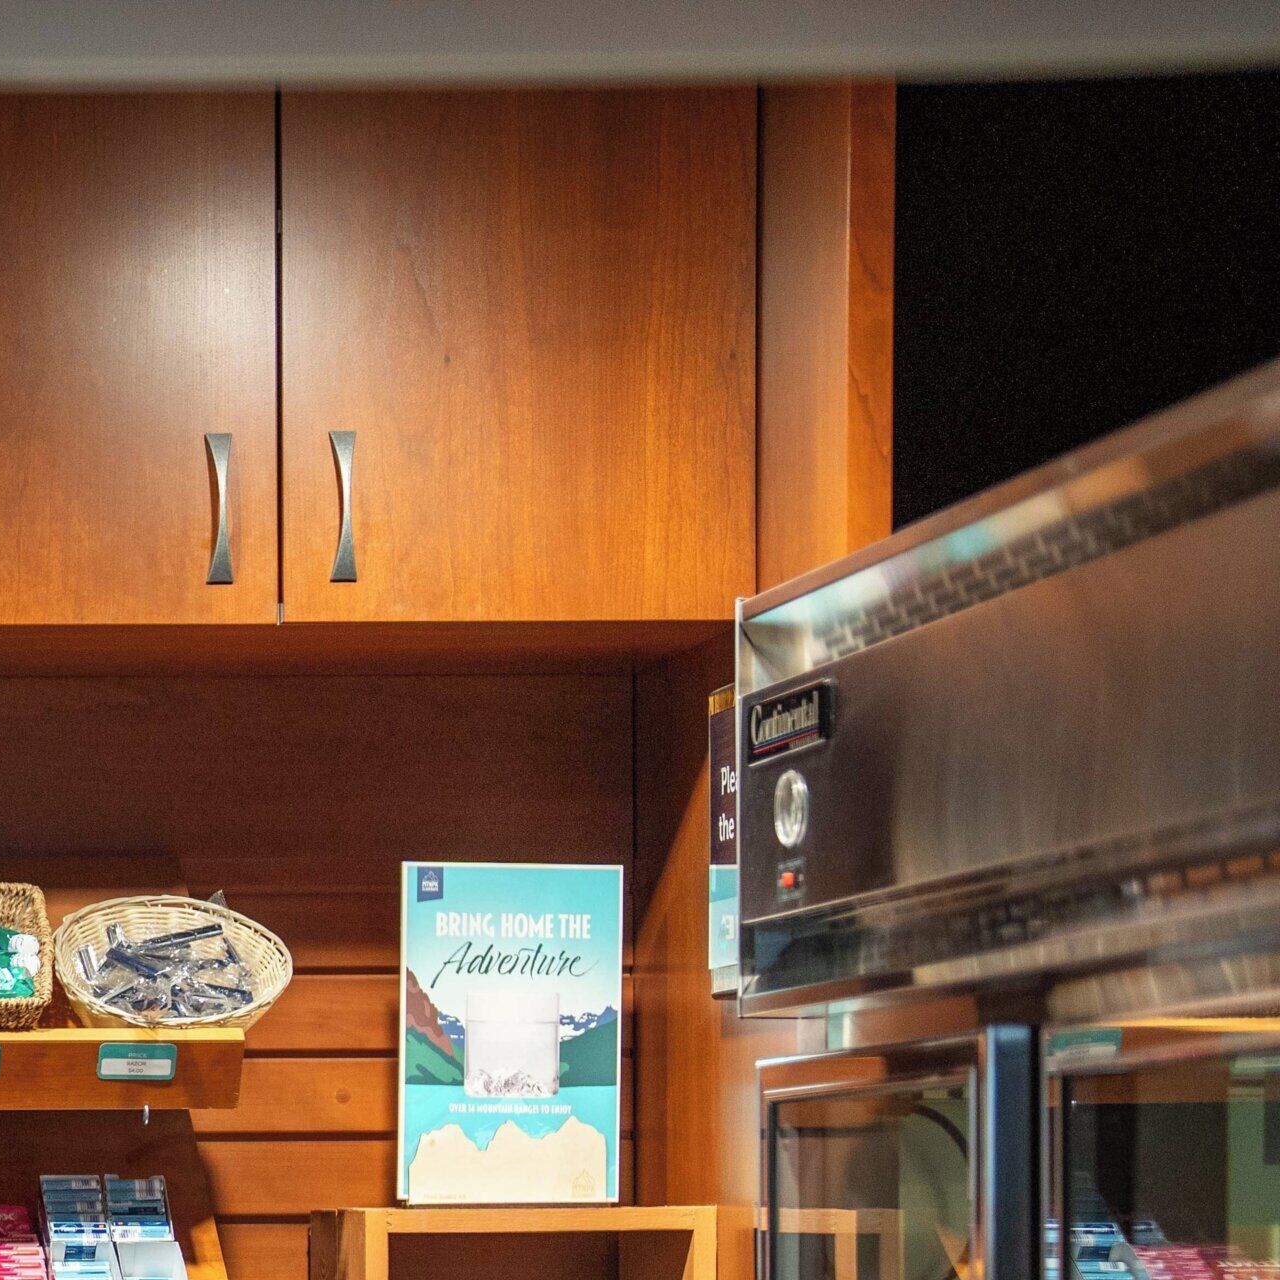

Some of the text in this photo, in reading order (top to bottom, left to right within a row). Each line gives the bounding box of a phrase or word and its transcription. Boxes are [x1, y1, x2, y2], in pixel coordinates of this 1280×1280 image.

[719, 812, 734, 842] the
[435, 911, 591, 939] BRING HOME THE
[430, 941, 600, 989] Adventure
[449, 1104, 466, 1113] OVER
[541, 1105, 549, 1113] TO
[552, 1105, 572, 1114] ENJOY
